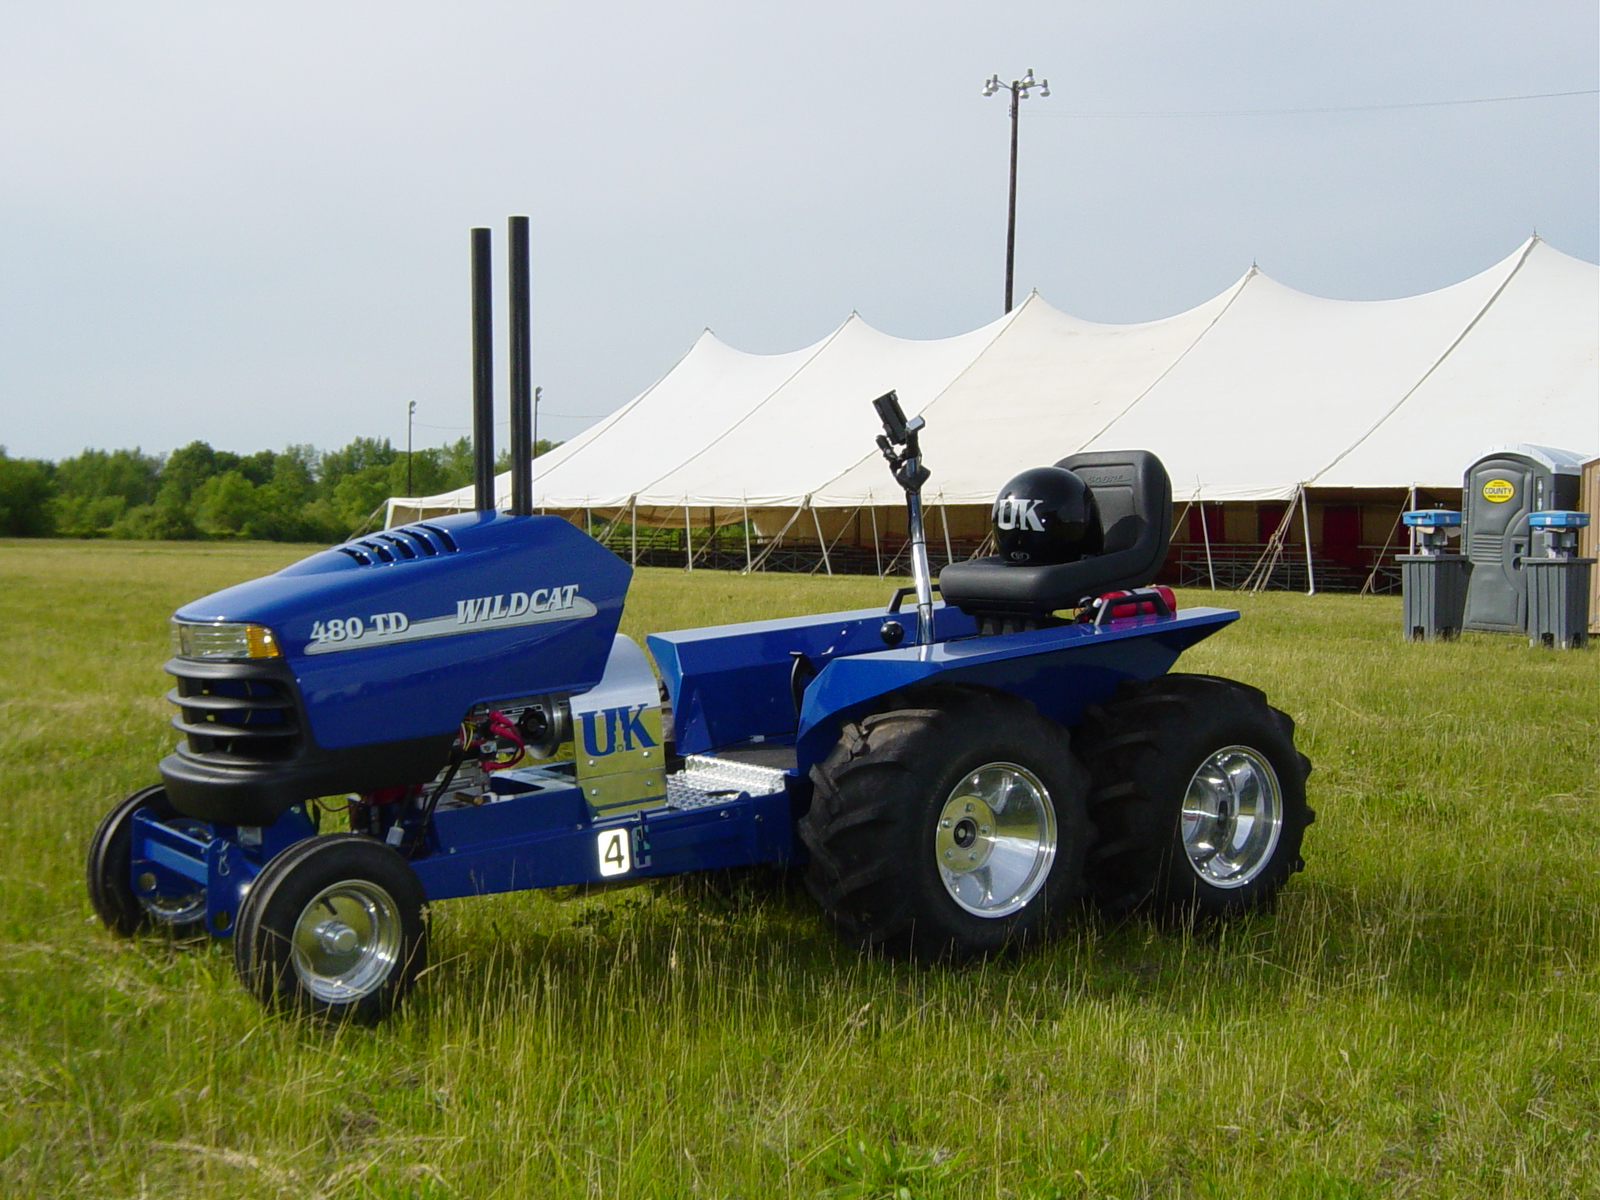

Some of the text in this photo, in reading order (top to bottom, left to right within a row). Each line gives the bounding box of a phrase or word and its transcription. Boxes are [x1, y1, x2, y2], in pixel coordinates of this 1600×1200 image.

[1484, 487, 1512, 495] COUNTY
[997, 498, 1046, 532] UK
[309, 583, 580, 644] 480 TD WILDCAT
[577, 703, 660, 757] UK
[604, 834, 625, 868] 4
